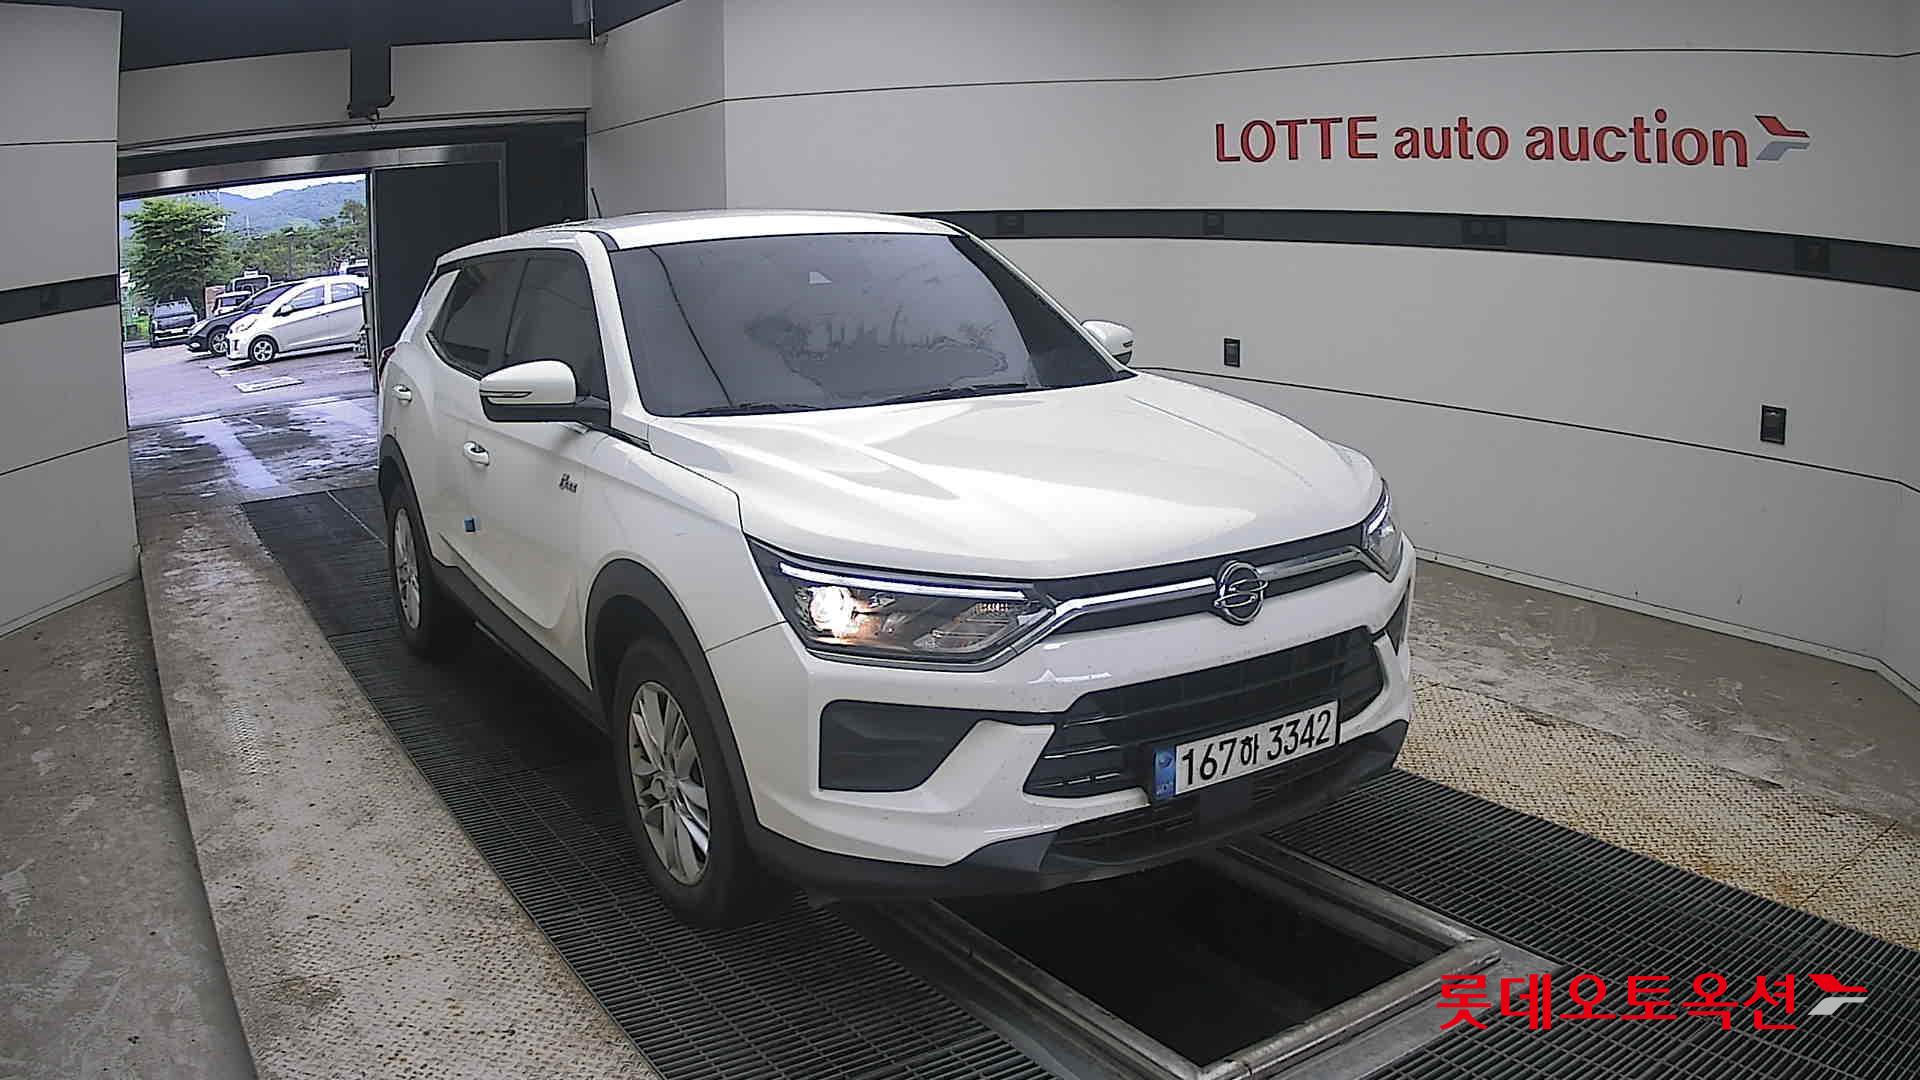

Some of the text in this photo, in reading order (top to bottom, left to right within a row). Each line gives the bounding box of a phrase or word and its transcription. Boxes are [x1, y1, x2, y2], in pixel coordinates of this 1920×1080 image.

[1215, 108, 1749, 168] LOTTE auto auction
